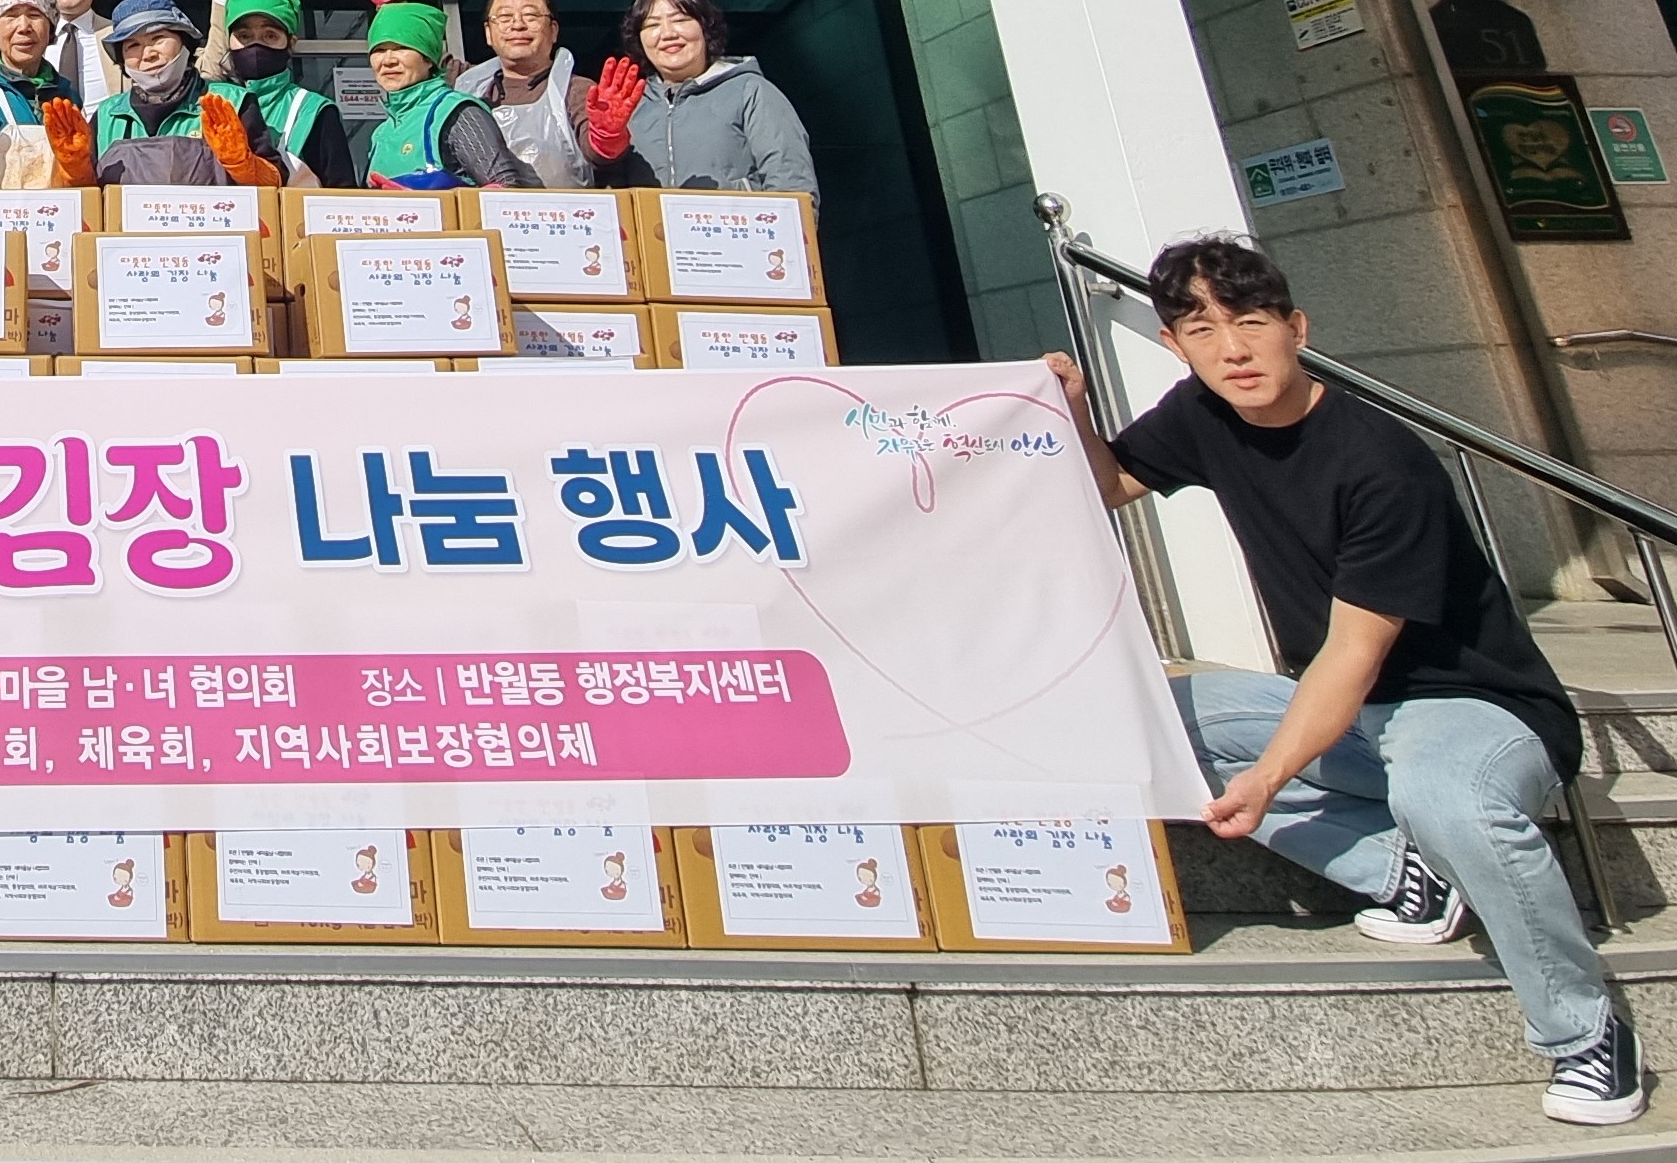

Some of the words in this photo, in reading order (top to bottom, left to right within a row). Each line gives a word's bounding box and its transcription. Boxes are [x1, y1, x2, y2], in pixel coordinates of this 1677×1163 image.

[125, 270, 160, 282] 사랑의
[170, 270, 190, 283] 김장
[196, 269, 217, 282] 나눔
[369, 273, 403, 286] 사랑의
[413, 273, 433, 285] 김장
[440, 272, 461, 286] 나눔
[1010, 431, 1065, 456] 안산
[292, 450, 530, 567] 나눔
[548, 446, 802, 565] 행사
[188, 663, 297, 708] 협의회
[360, 668, 428, 708] 장소
[456, 663, 565, 708] 반월동
[575, 660, 792, 705] 행정복지센터
[77, 723, 212, 774] 체육회,
[235, 720, 599, 769] 지역사회보장협의체
